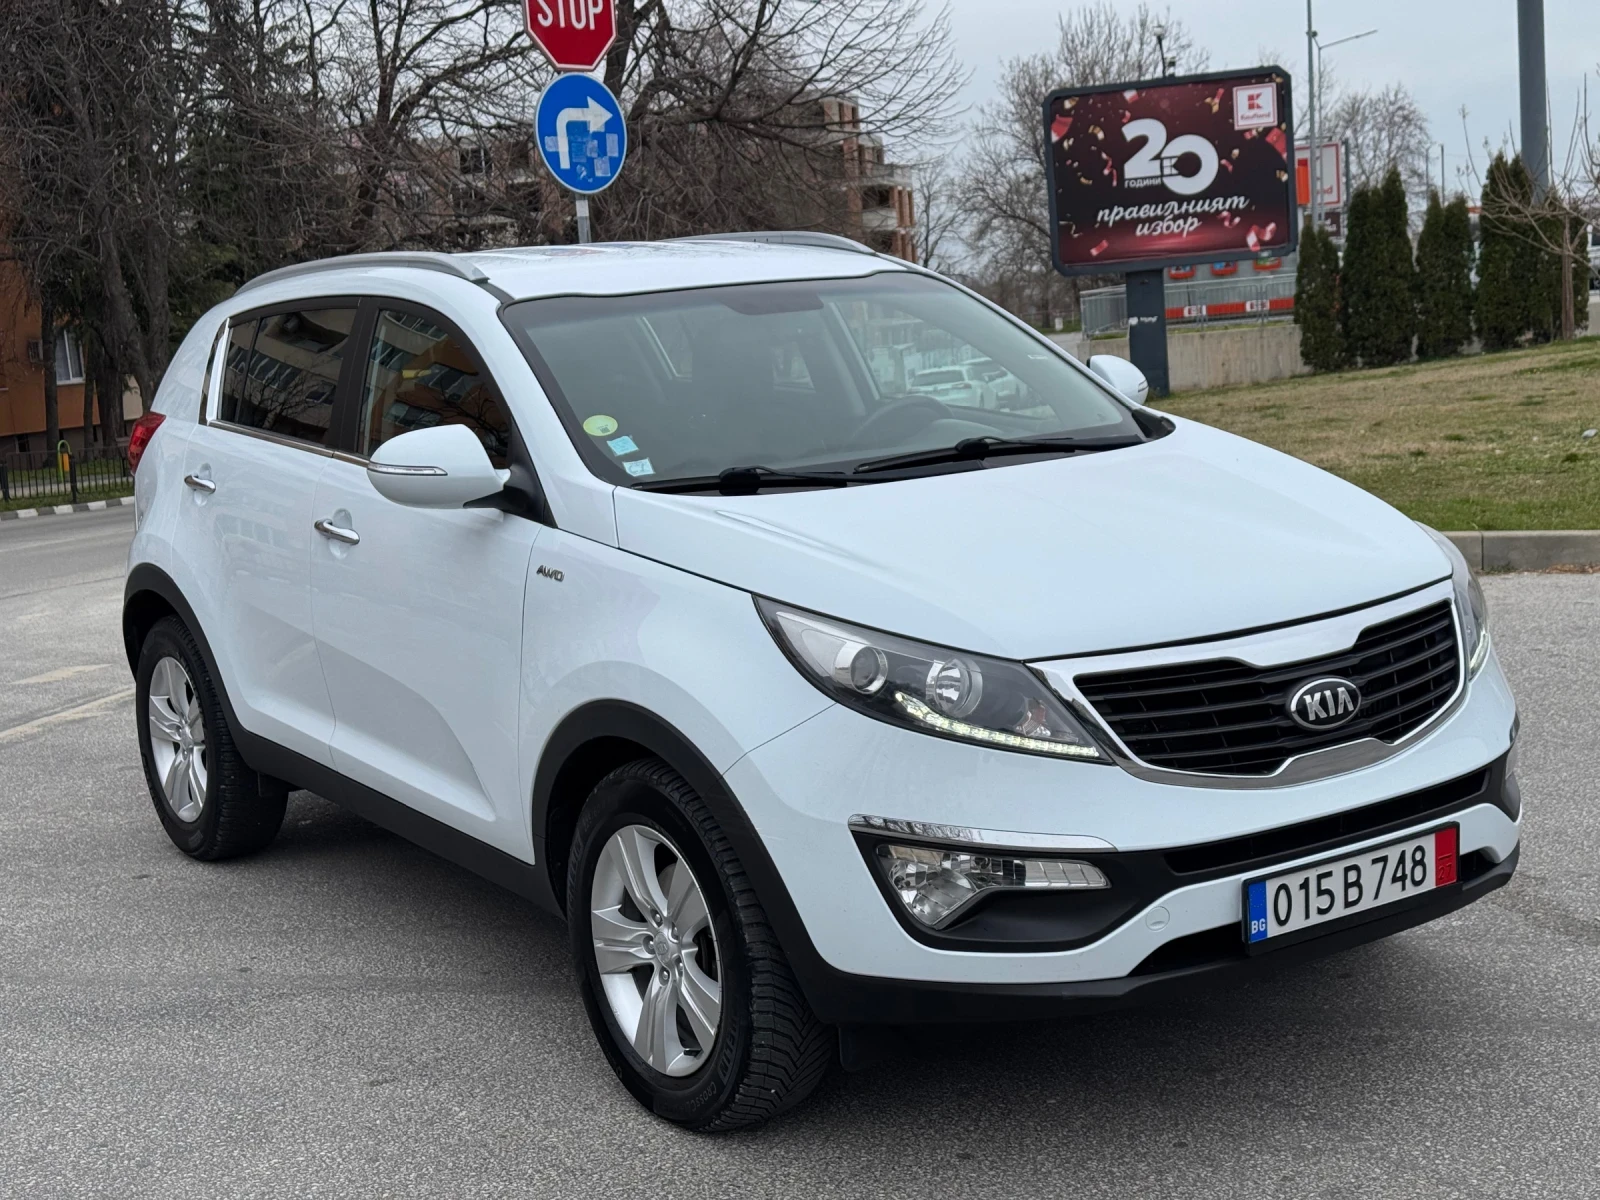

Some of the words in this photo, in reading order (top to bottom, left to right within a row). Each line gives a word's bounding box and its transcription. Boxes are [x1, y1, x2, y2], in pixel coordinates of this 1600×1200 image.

[536, 0, 604, 30] STOP
[1135, 213, 1202, 238] избор
[536, 564, 565, 582] AWD
[1303, 686, 1354, 721] KIA
[1251, 918, 1266, 934] BG
